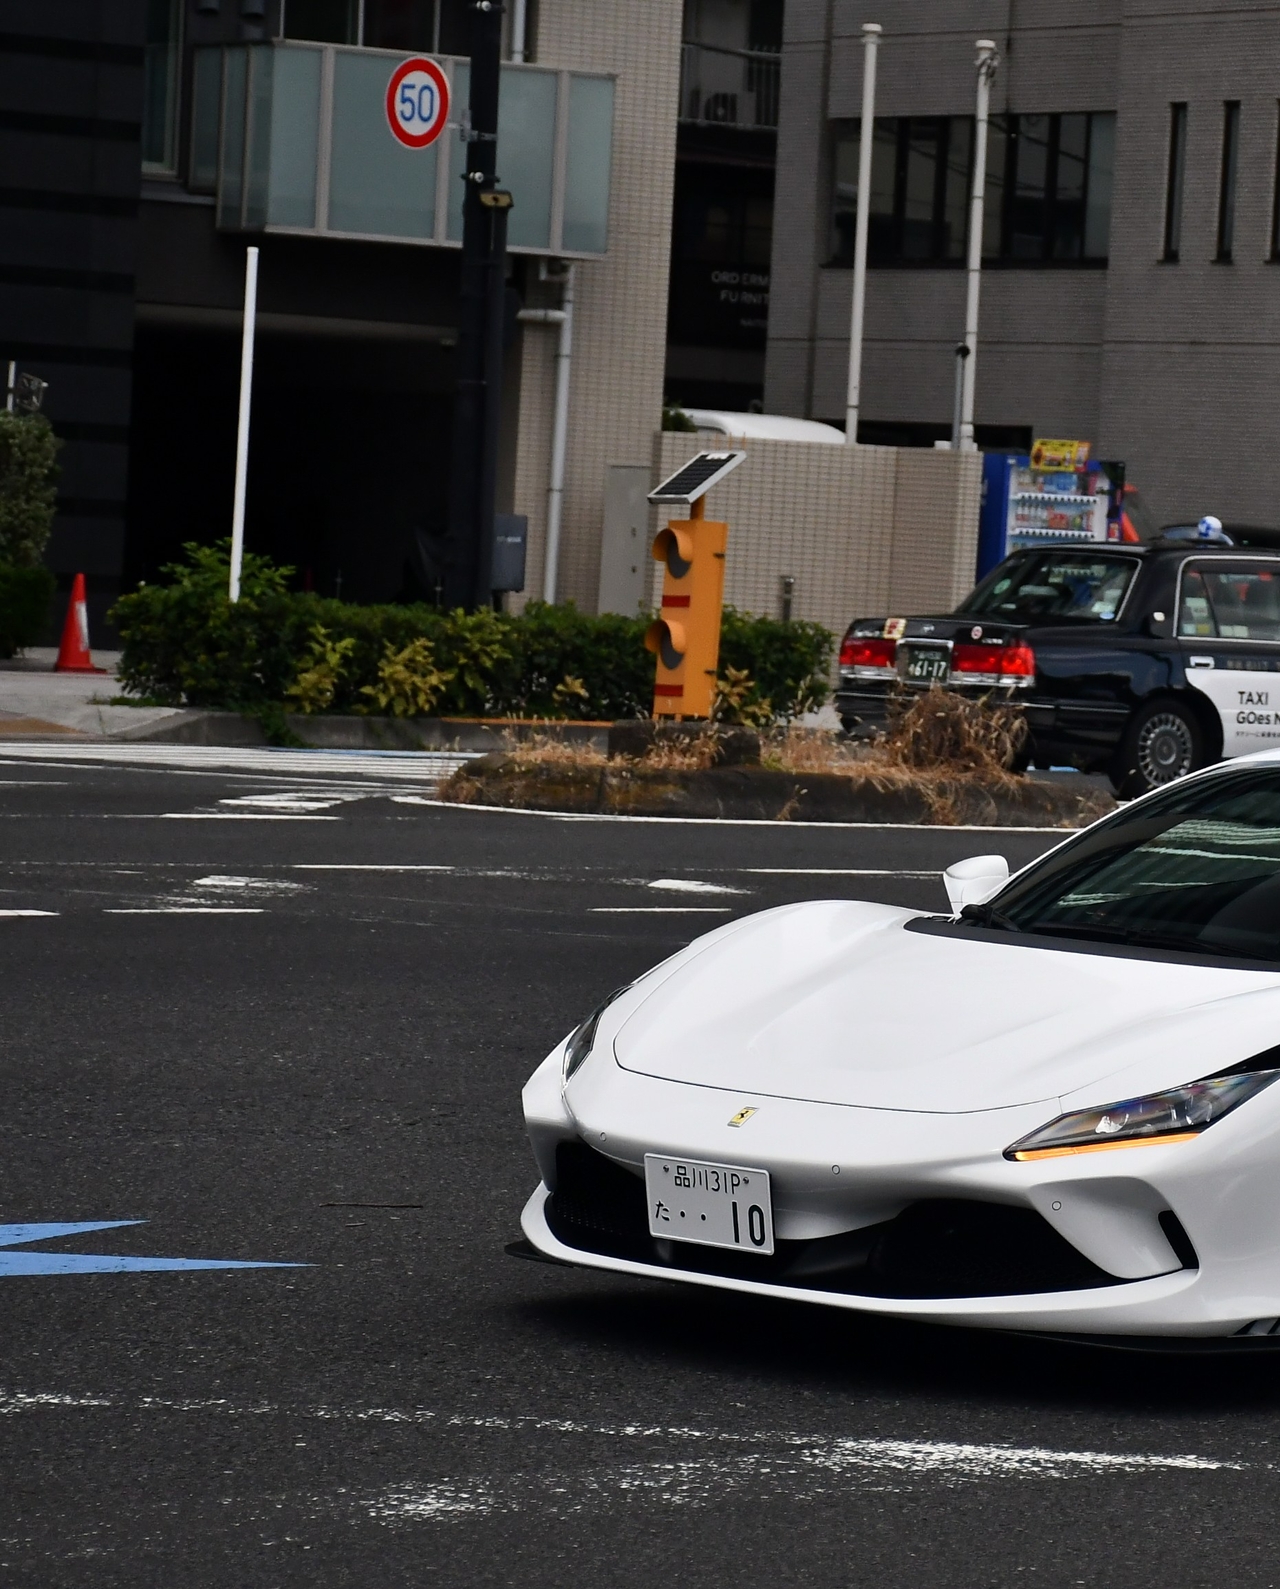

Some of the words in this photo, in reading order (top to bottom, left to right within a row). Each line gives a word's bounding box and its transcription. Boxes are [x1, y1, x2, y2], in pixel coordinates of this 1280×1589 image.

[400, 84, 434, 122] 50
[1238, 691, 1269, 706] TAXI
[1236, 711, 1271, 725] GOes
